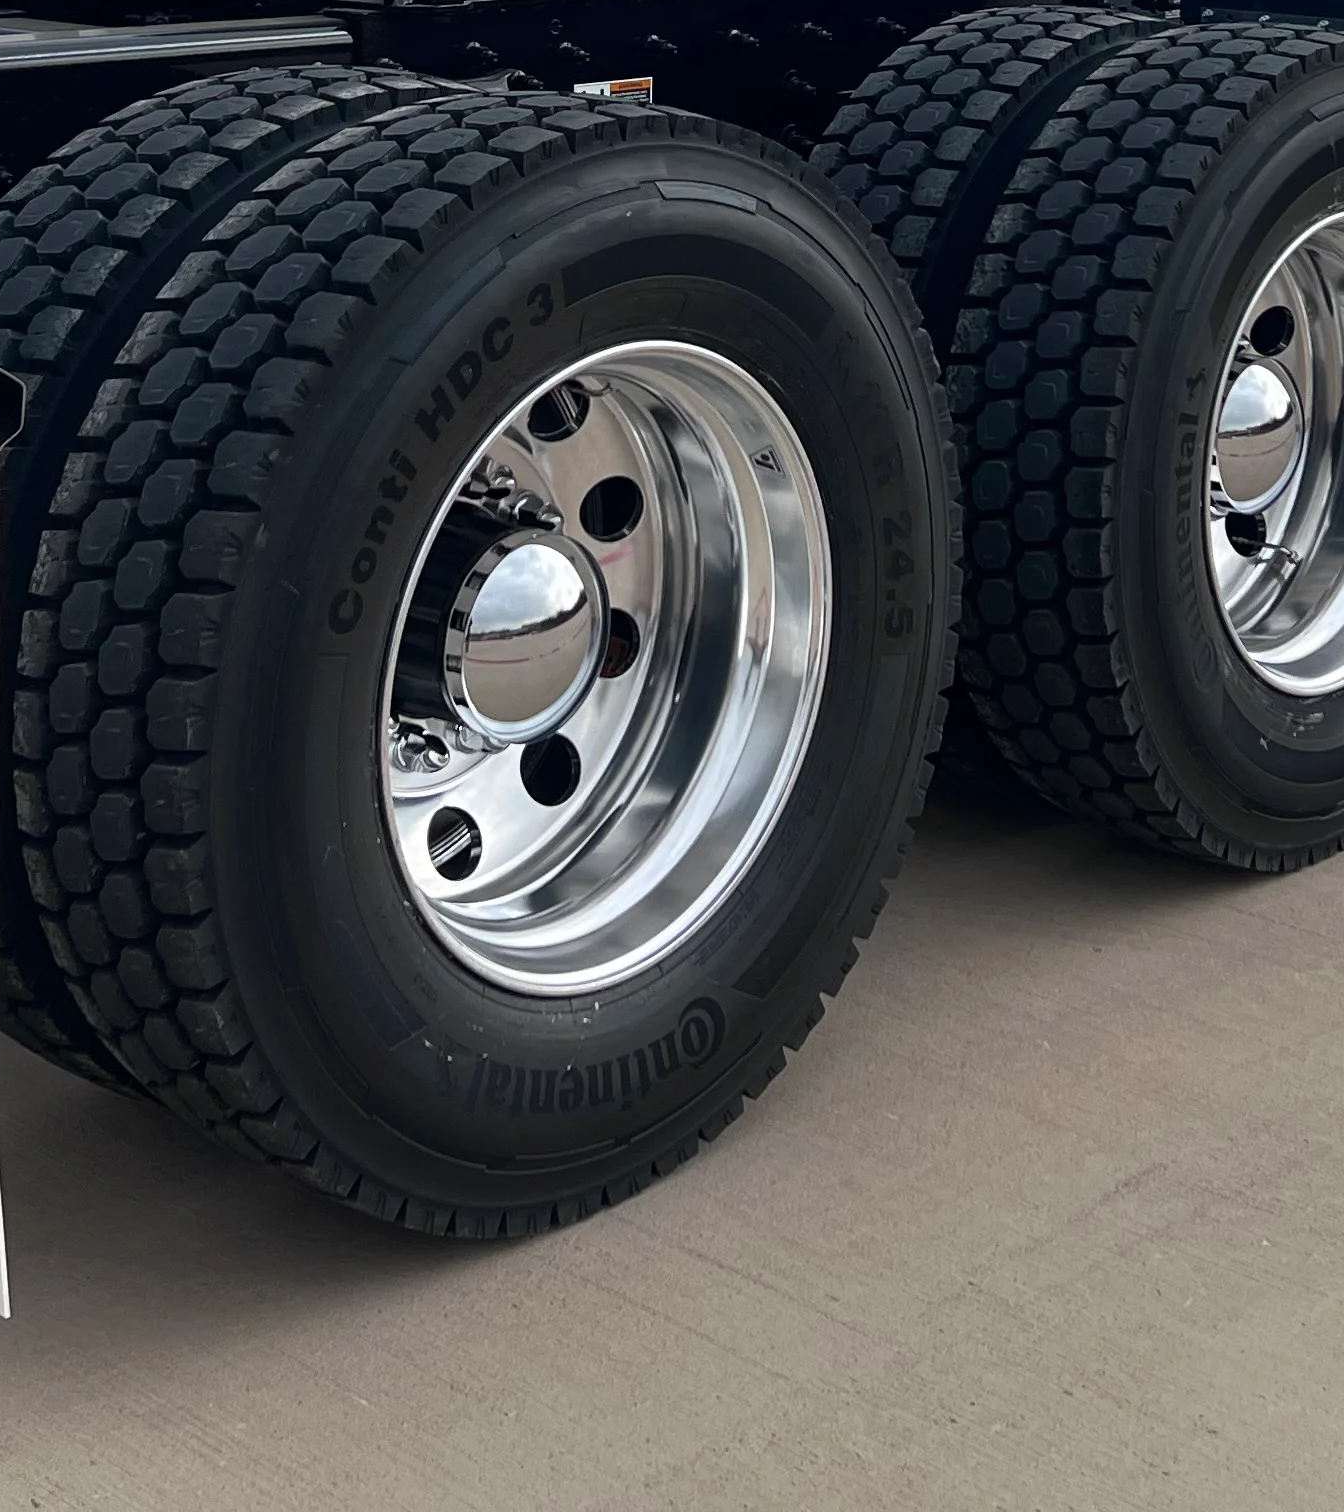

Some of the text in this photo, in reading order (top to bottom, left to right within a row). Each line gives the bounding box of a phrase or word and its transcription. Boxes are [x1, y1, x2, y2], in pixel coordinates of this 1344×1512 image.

[328, 283, 555, 635] Conti HDC 3
[1175, 411, 1220, 694] Continental
[882, 510, 916, 639] 24.5
[462, 995, 727, 1118] Continental
